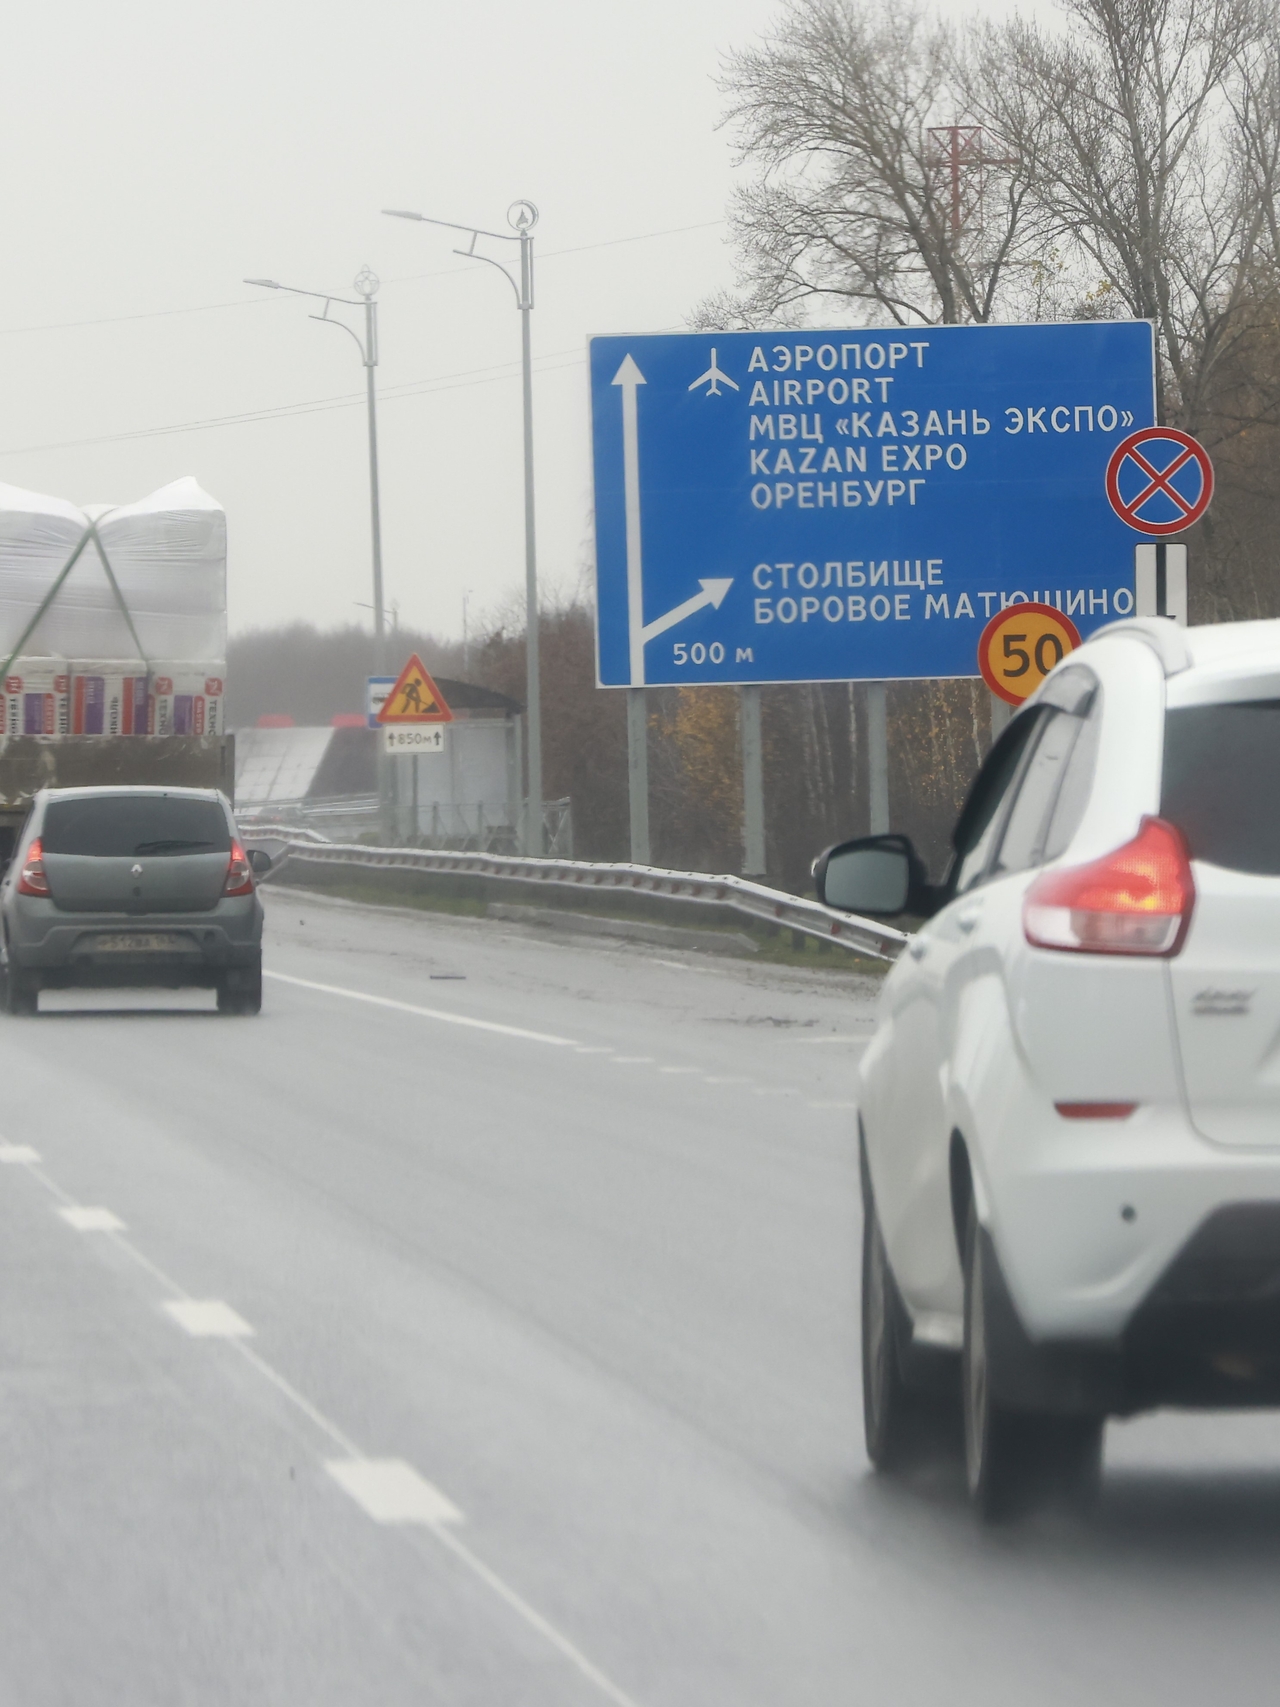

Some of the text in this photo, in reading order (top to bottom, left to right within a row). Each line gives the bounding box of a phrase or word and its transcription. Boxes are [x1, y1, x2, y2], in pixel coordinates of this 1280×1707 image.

[747, 342, 930, 372] АЭРОПОРТ
[748, 377, 894, 406] AIRPORT
[749, 404, 1134, 444] МВЦ «КАЗАНЬ ЭКСПО»
[750, 443, 967, 475] KAZAN EXPO
[750, 479, 926, 510] ОРЕНБУРГ
[752, 559, 944, 590] СТОЛБИЩЕ
[754, 594, 911, 624] БОРОВОЕ
[673, 641, 725, 665] 500
[1002, 633, 1063, 677] 50
